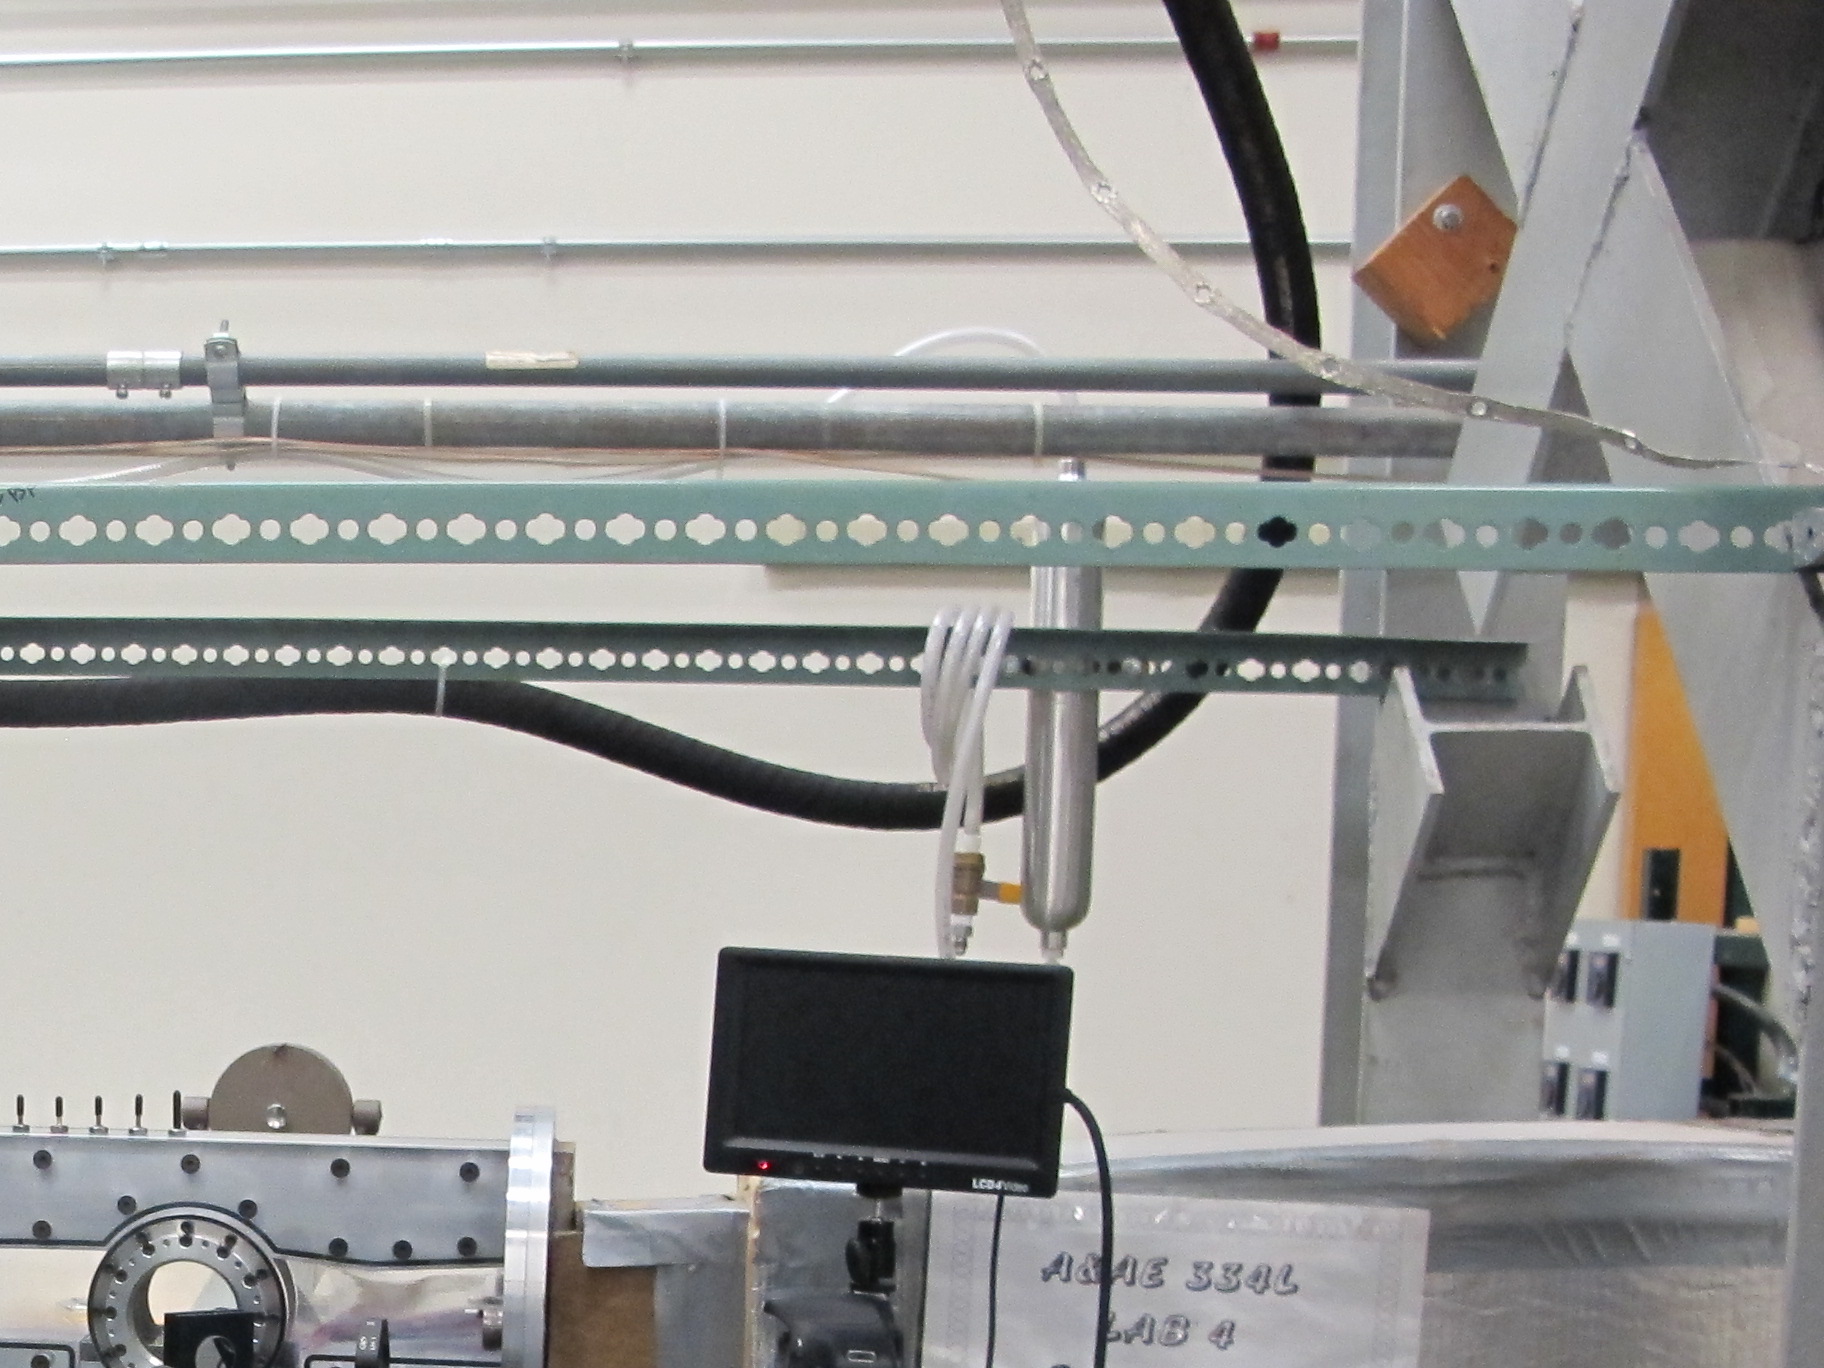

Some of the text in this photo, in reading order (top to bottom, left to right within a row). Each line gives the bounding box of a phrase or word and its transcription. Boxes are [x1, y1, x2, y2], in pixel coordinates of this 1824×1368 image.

[1040, 1251, 1299, 1296] A&AE 334L
[1104, 1310, 1236, 1351] LAB 4
